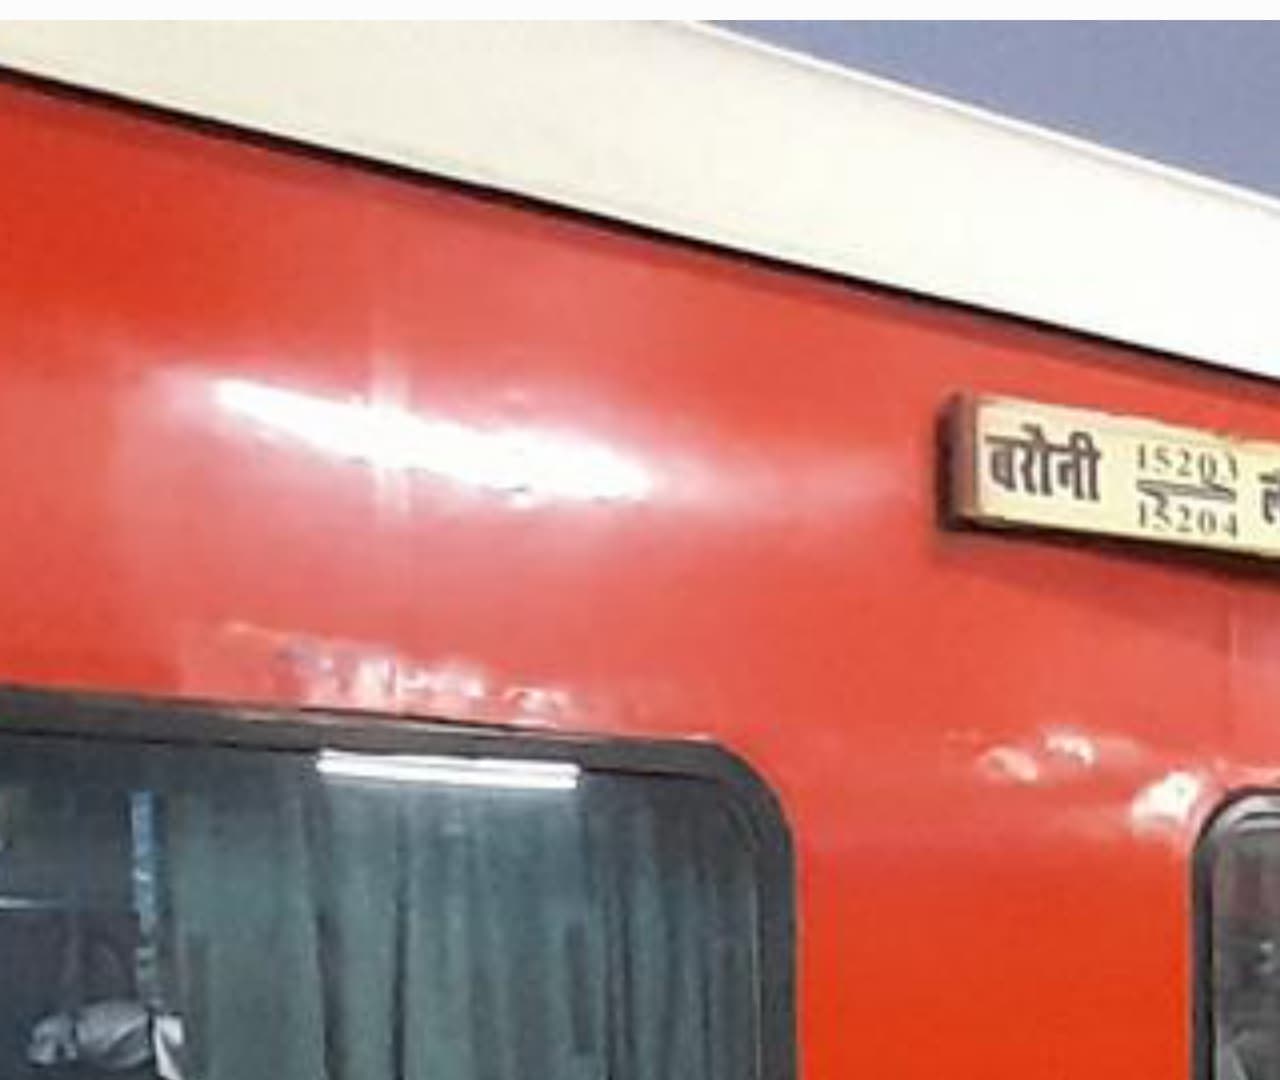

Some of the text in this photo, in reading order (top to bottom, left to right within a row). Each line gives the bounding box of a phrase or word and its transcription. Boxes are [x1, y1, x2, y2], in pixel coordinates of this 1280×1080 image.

[985, 423, 1102, 502] बरौनी
[1137, 442, 1239, 482] 15203
[1138, 499, 1239, 540] 15204
